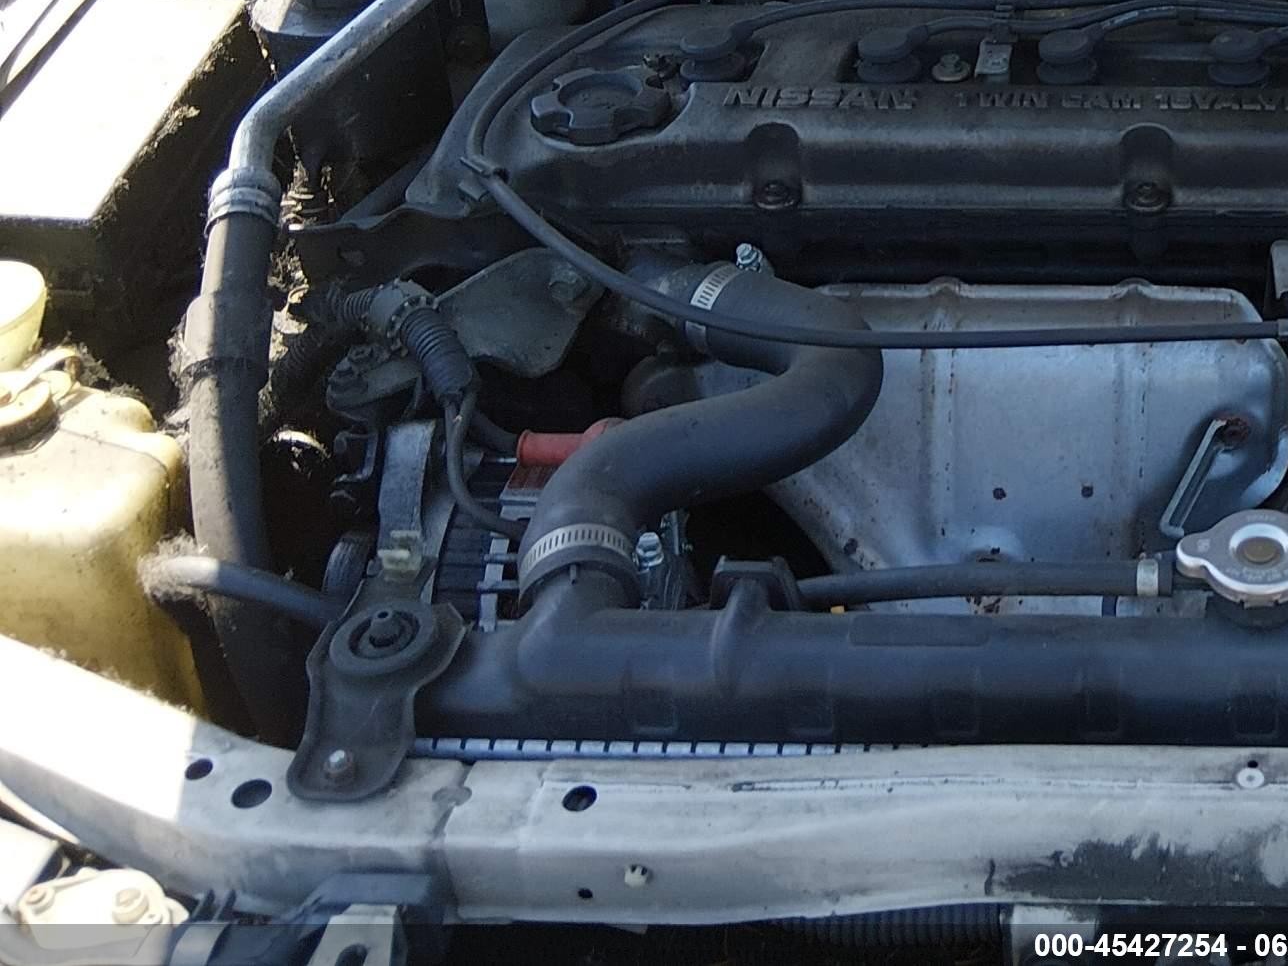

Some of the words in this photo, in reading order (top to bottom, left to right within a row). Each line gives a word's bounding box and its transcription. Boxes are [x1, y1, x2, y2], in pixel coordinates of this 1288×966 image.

[722, 86, 914, 110] NISSAN
[955, 91, 1048, 110] TWIN
[1062, 92, 1142, 110] CAM
